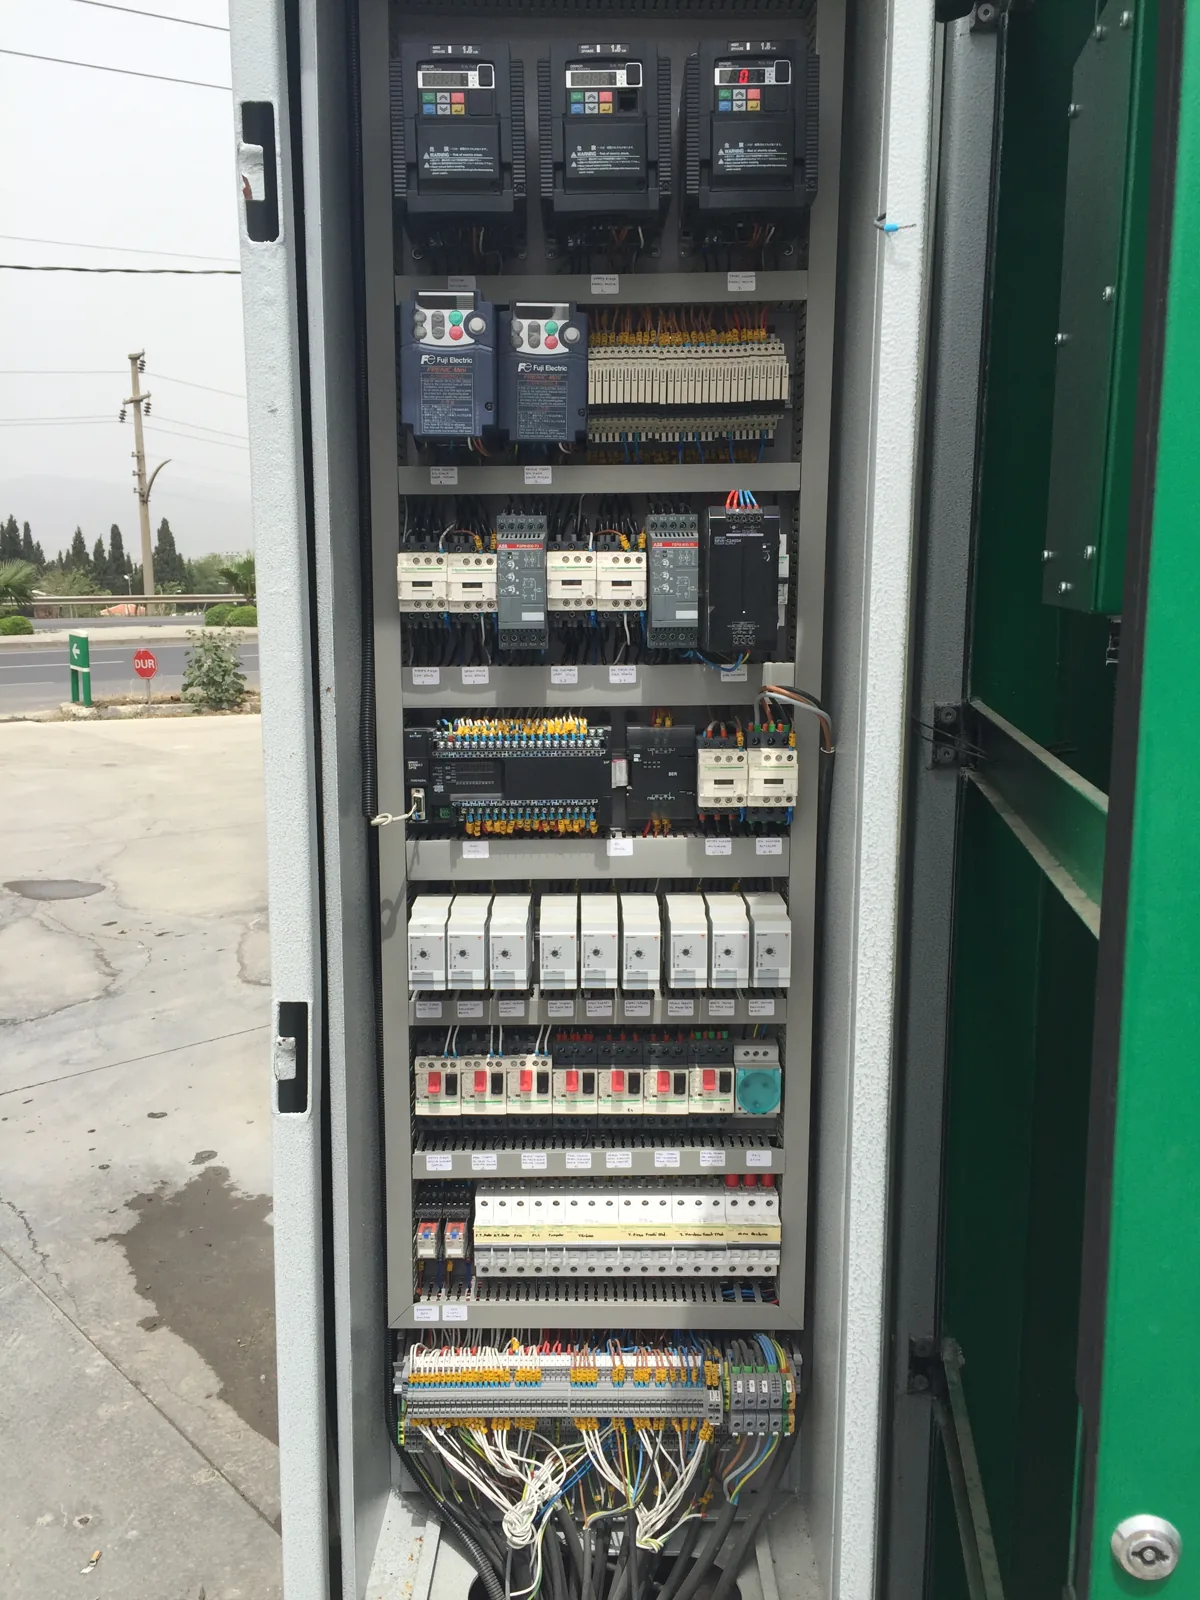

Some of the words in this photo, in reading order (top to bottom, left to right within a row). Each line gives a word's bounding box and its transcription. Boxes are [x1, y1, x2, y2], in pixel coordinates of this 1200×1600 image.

[437, 356, 449, 365] Fuji
[449, 356, 473, 364] Electric
[533, 364, 544, 372] Fuji
[545, 364, 568, 372] Electric
[135, 659, 155, 669] DUR
